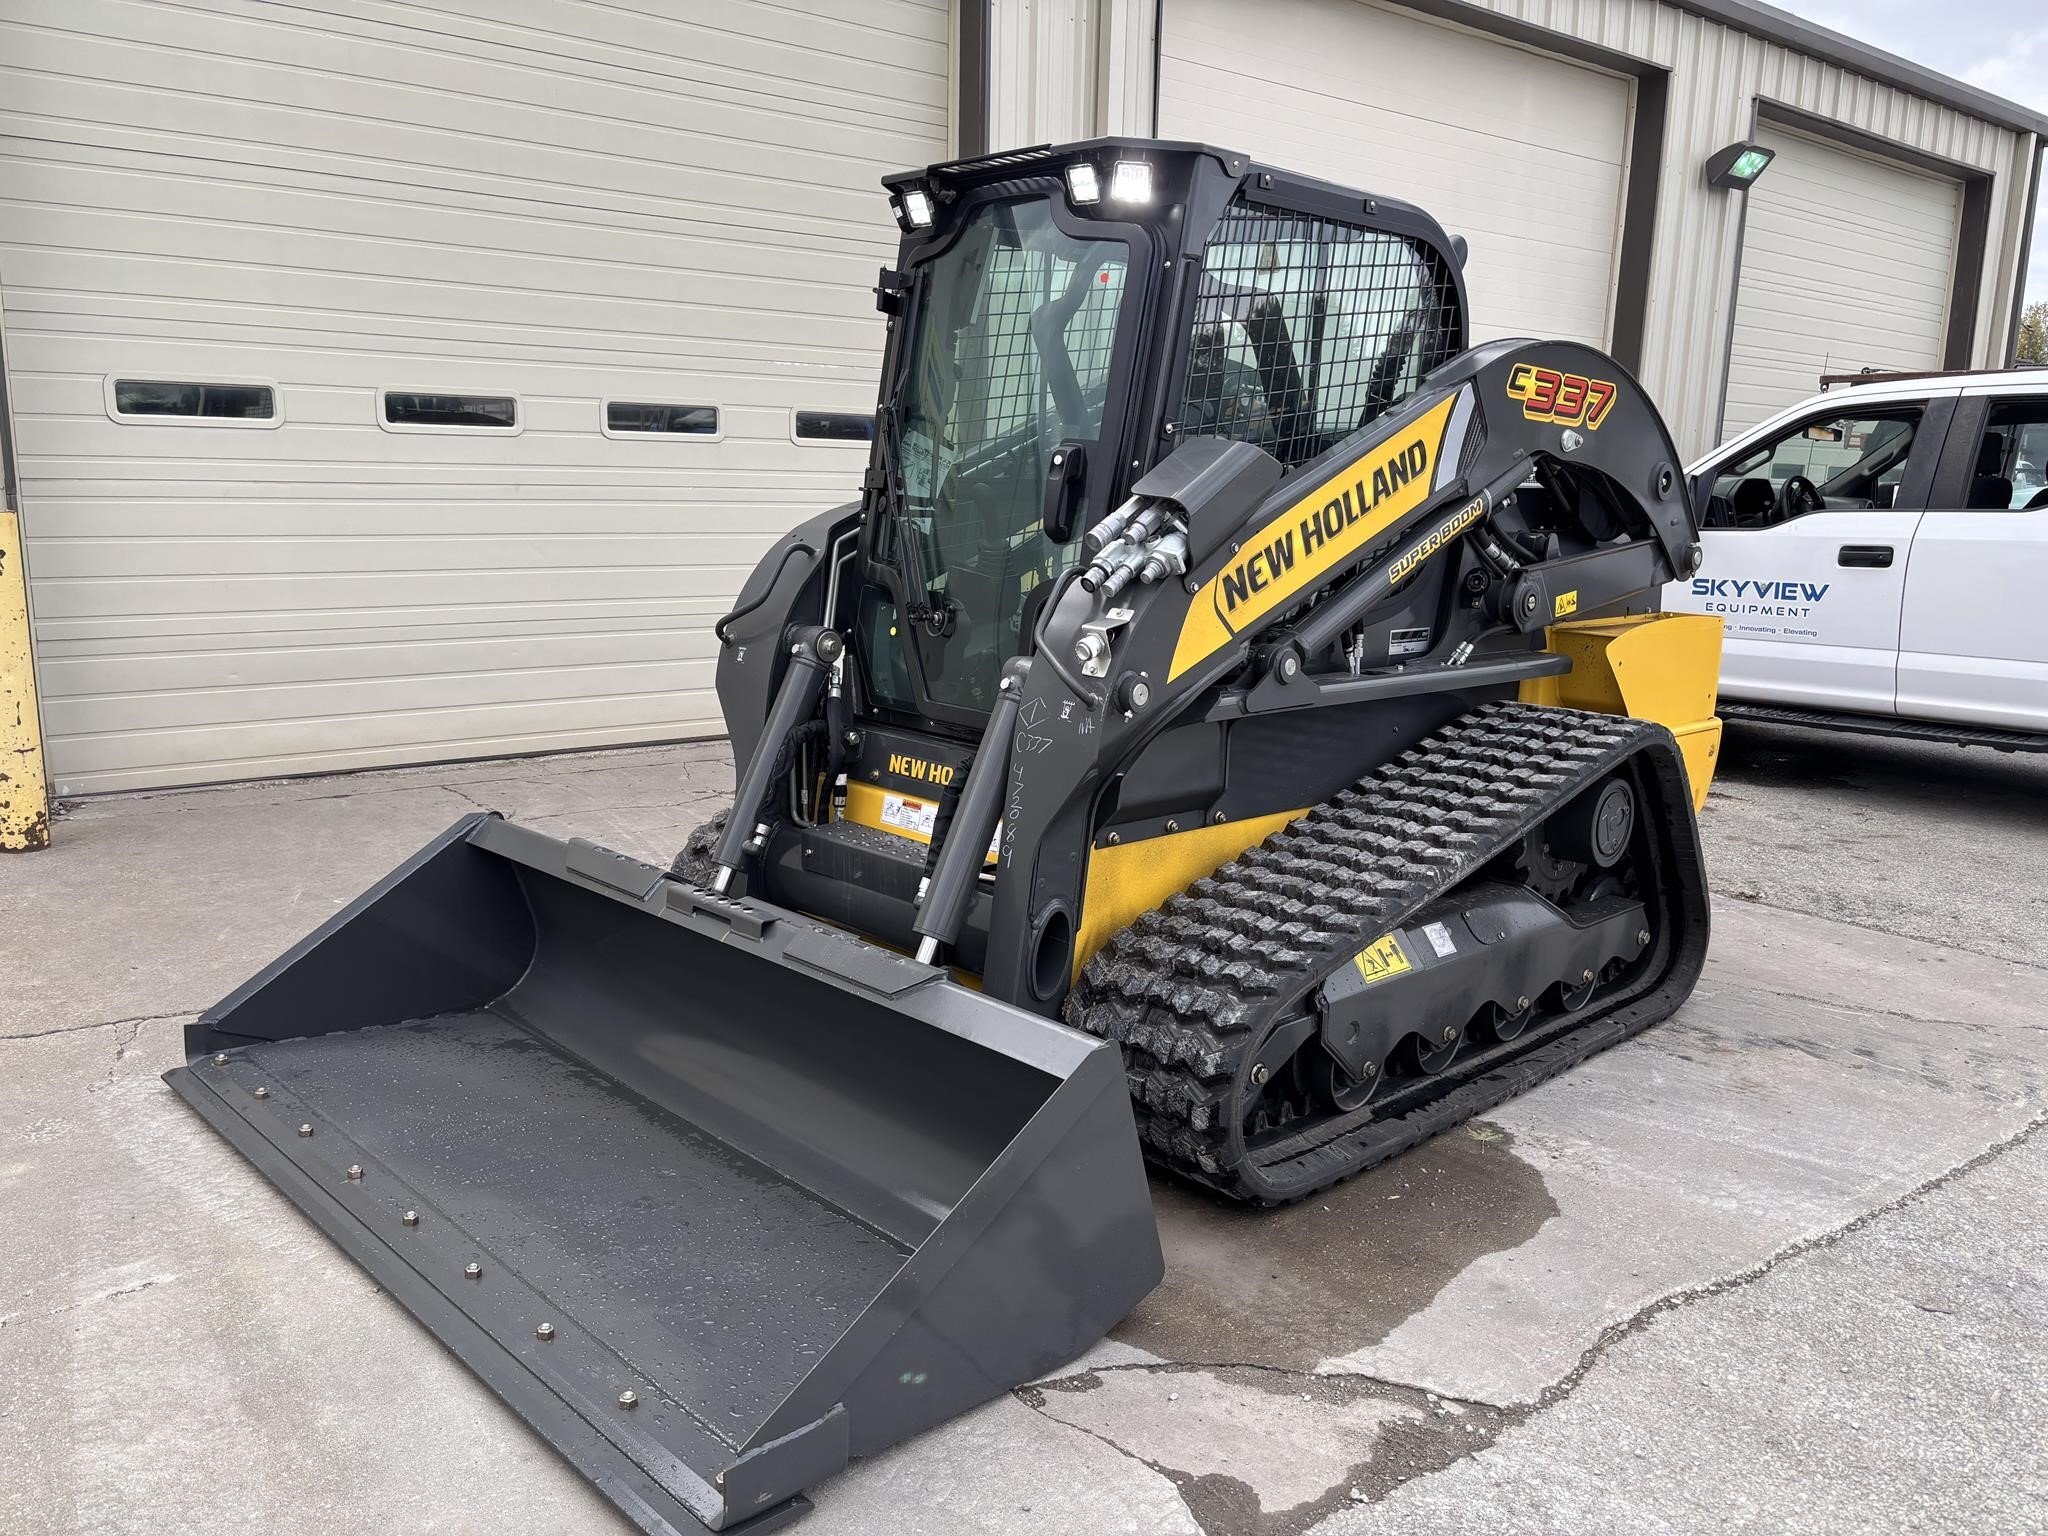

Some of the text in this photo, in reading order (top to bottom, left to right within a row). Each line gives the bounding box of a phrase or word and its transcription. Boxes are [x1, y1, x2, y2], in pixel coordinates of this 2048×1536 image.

[1508, 364, 1616, 429] C337
[1222, 439, 1427, 613] NEW HOLLAND
[1389, 498, 1483, 584] SUPER BOOM
[1692, 578, 1830, 602] SKYVIEW
[1705, 602, 1810, 618] EQUIPMENT
[1739, 625, 1776, 634] Innovating
[1783, 628, 1817, 637] Elevating
[889, 754, 927, 779] NEW
